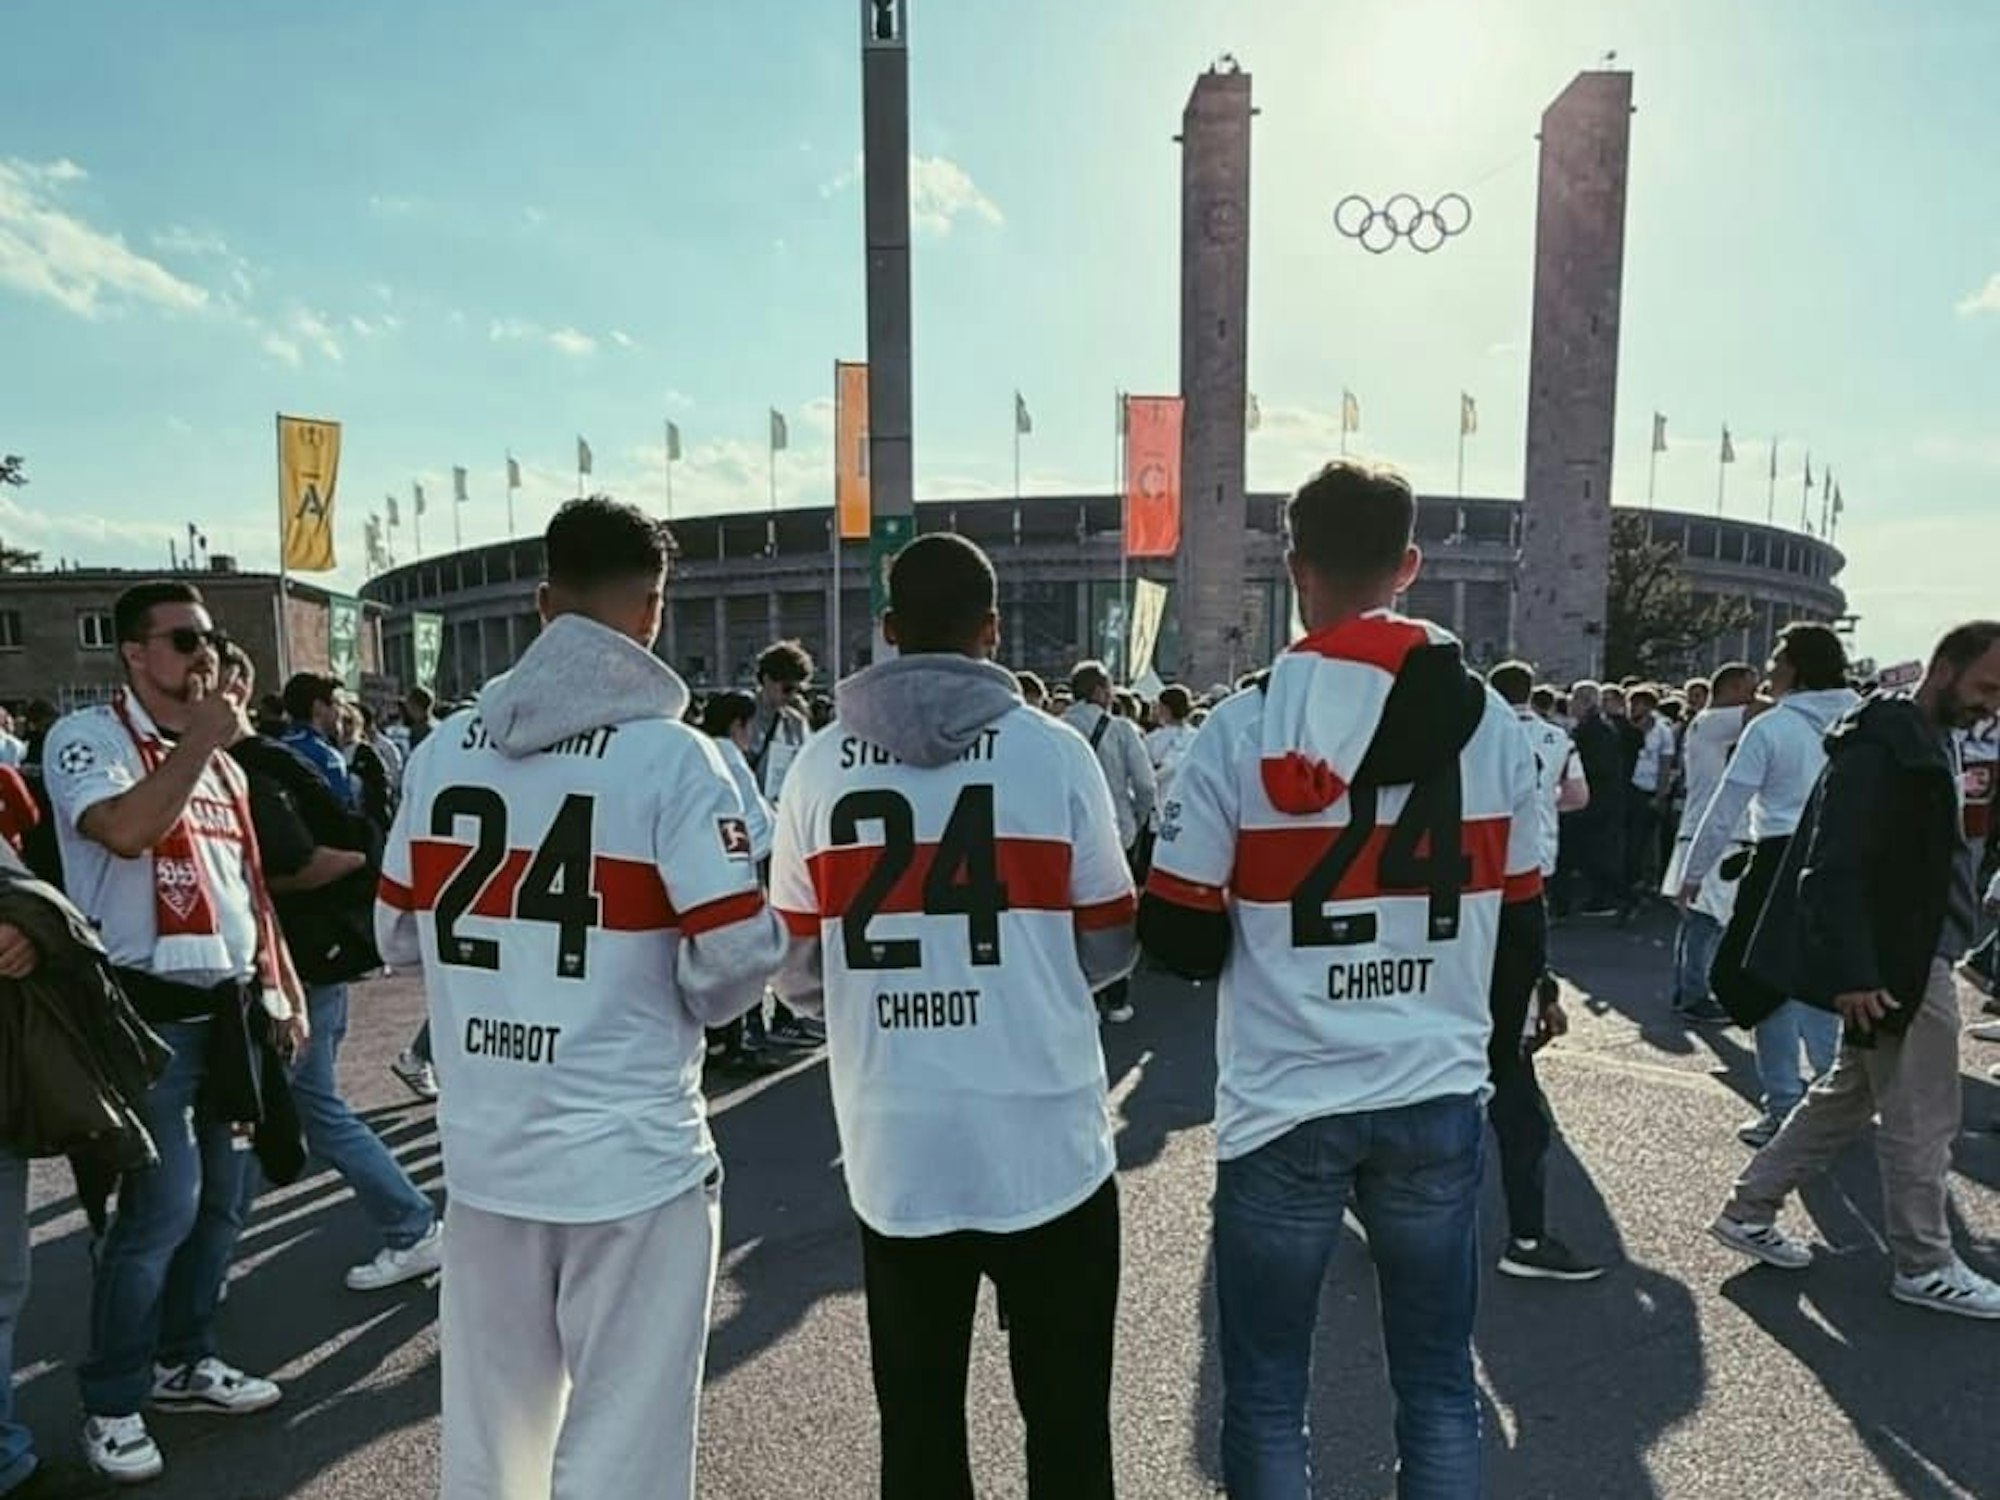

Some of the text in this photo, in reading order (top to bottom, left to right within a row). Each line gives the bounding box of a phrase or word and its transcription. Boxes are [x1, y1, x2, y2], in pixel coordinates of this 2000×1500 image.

[295, 482, 325, 521] A
[430, 785, 600, 979] 24
[829, 784, 1009, 969] 24
[1291, 776, 1474, 948] 24
[1327, 958, 1435, 1001] CHABOT
[876, 989, 980, 1029] CHABOT
[465, 1017, 561, 1065] CHABOT
